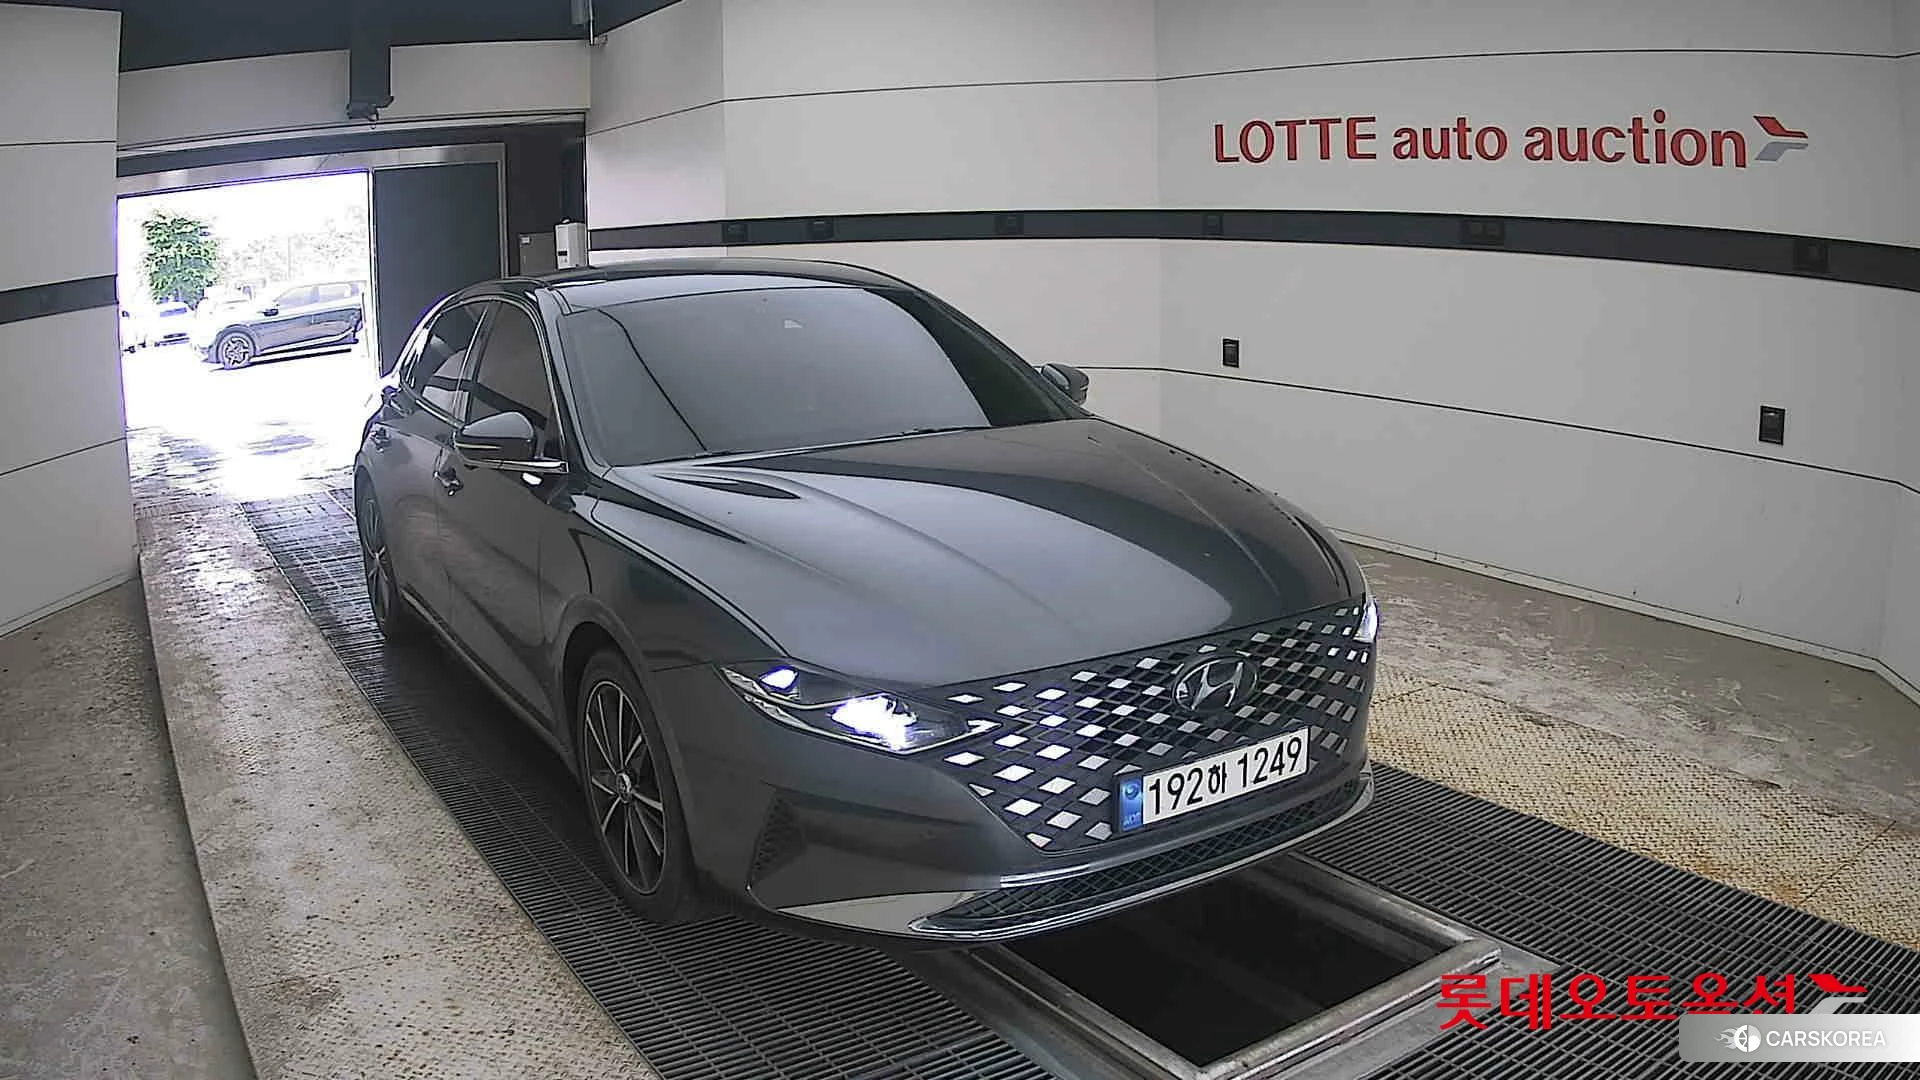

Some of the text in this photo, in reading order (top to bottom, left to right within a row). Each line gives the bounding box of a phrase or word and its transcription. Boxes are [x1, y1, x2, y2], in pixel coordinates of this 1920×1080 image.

[1214, 109, 1746, 168] LOTTE auto auction
[1149, 736, 1302, 815] 192하 1249
